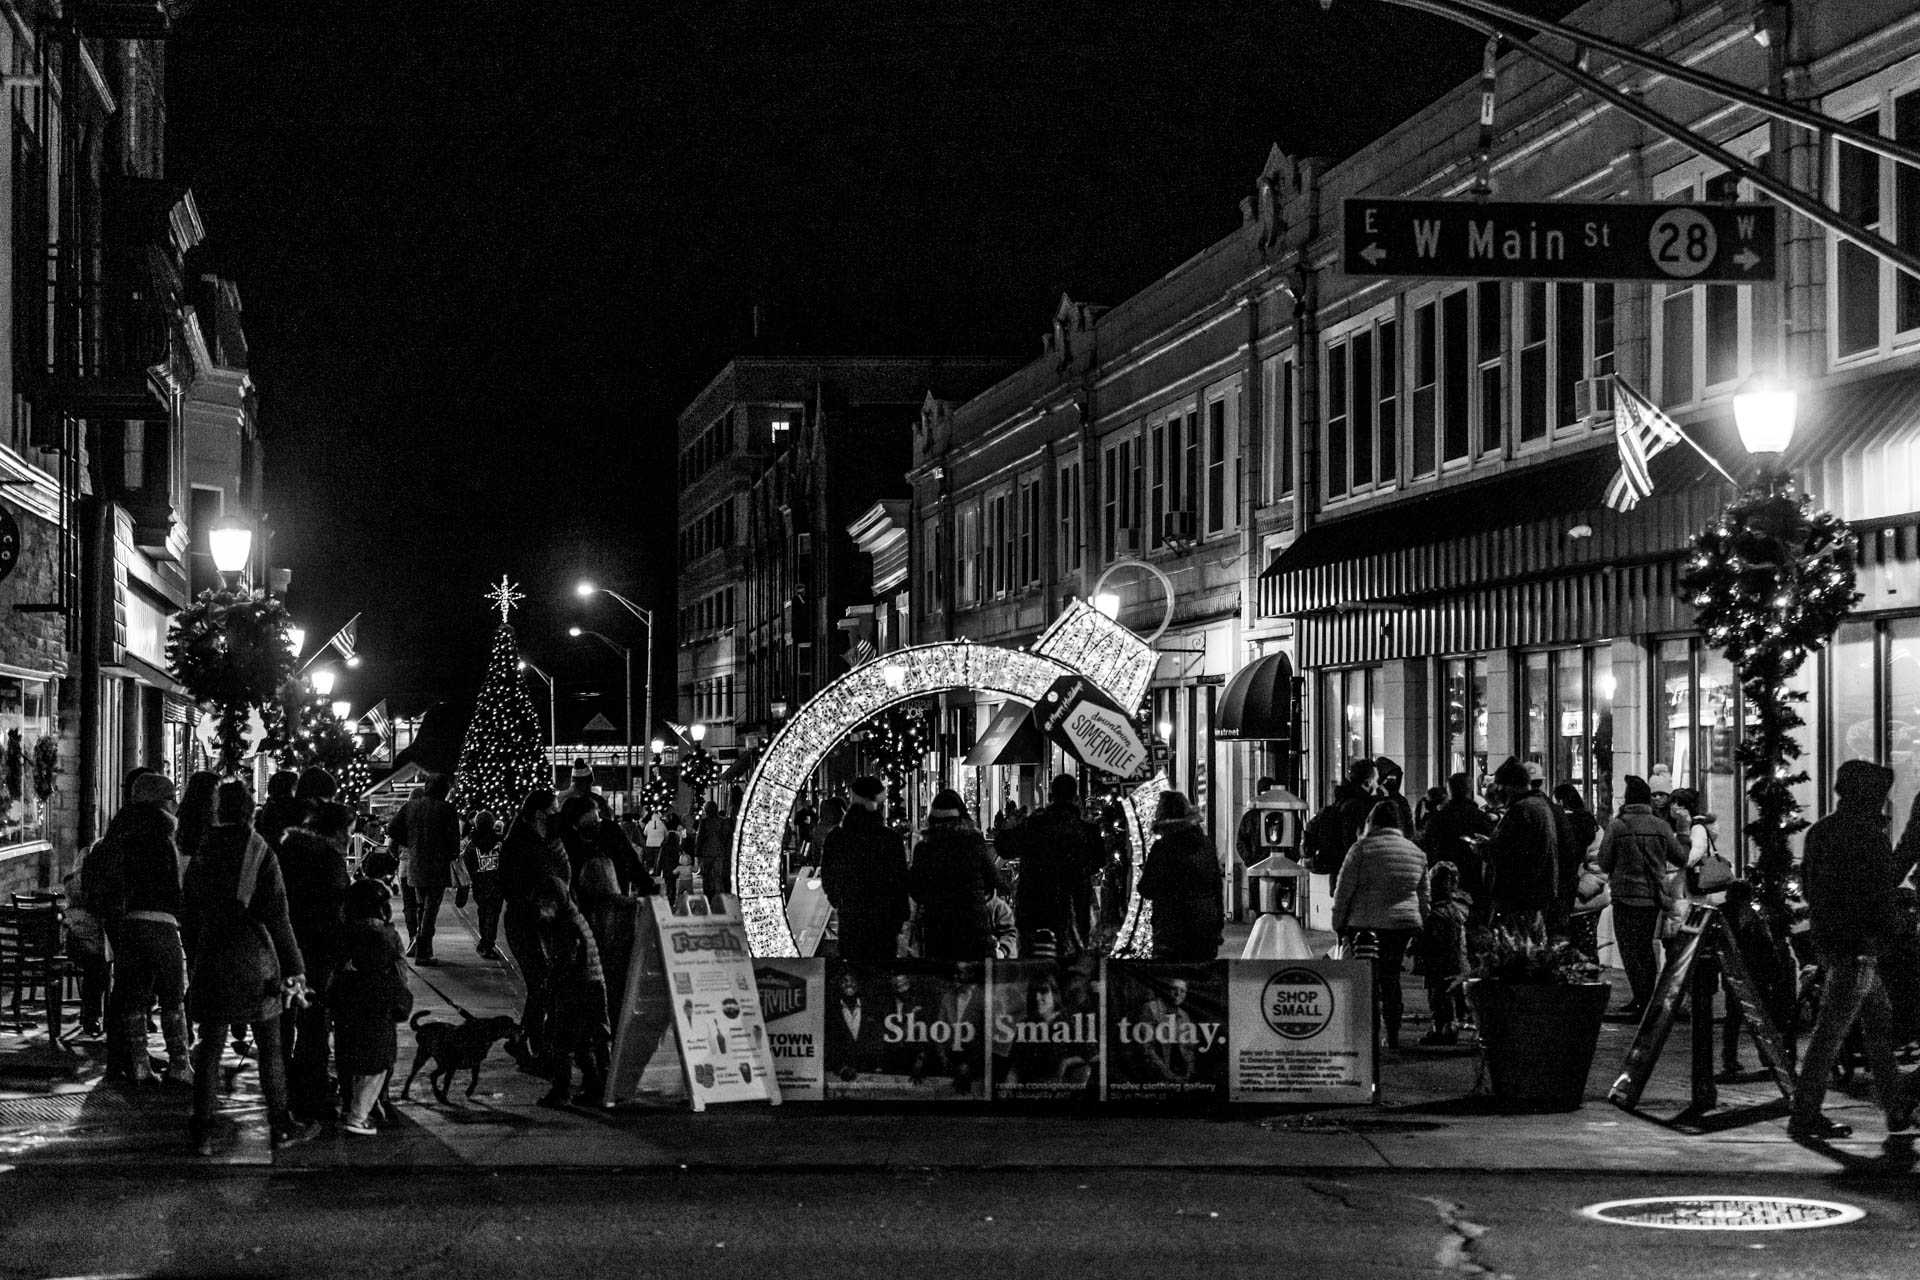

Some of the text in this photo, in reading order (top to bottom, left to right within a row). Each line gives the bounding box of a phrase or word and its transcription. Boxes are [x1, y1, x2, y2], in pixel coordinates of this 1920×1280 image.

[1366, 209, 1377, 233] E
[1737, 215, 1755, 241] W
[1413, 219, 1610, 260] W Main St
[1658, 222, 1708, 262] 28
[1071, 714, 1136, 770] SOMERVILLE
[1091, 712, 1132, 748] downtown
[671, 929, 743, 953] Fresh
[1277, 991, 1318, 1003] SHOP
[1273, 1004, 1323, 1016] SMALL
[883, 1012, 1228, 1053] Shop Small today.
[770, 1046, 815, 1057] VILLE
[1025, 1080, 1088, 1091] consignment
[1110, 1081, 1217, 1092] evolve clothing gallery
